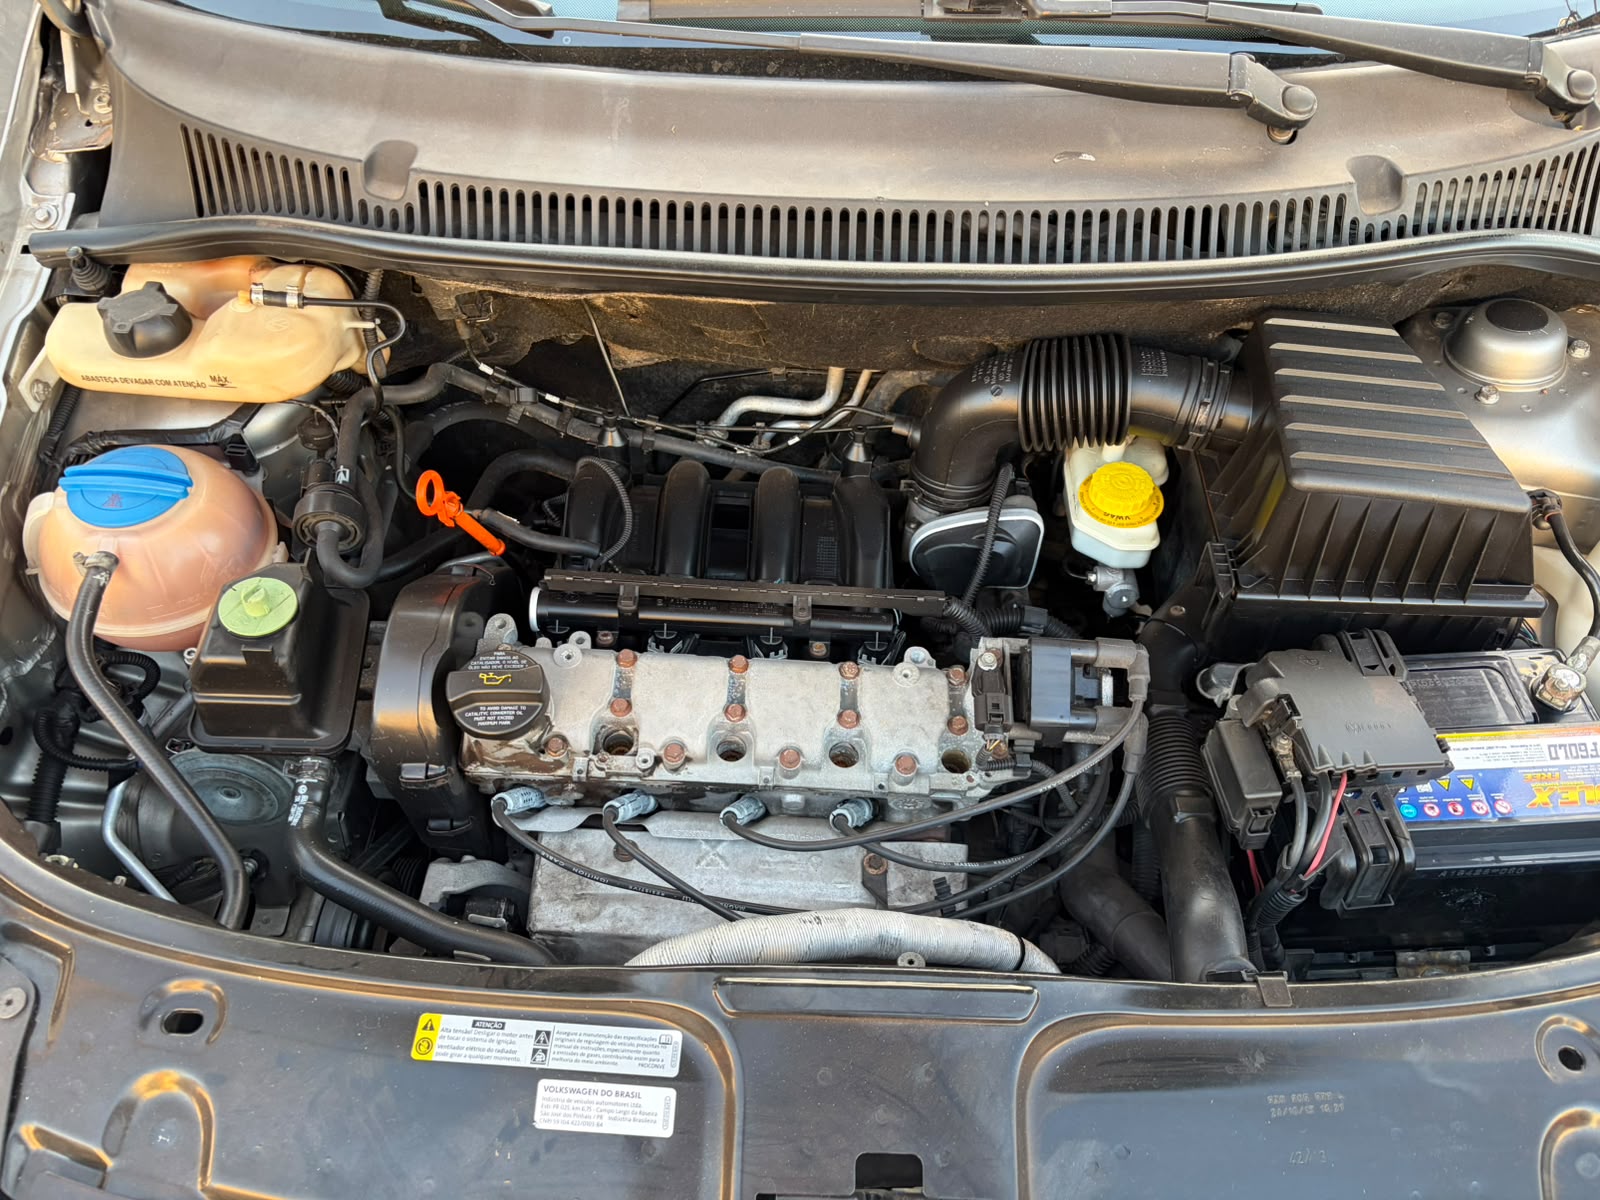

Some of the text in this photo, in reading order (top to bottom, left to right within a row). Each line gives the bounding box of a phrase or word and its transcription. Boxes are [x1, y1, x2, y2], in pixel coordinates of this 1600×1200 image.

[81, 375, 119, 384] ABASTEÇA
[173, 380, 206, 388] ATENÇÃO
[1527, 784, 1600, 808] LEX
[473, 1029, 495, 1037] Desligar
[543, 1085, 598, 1095] VOLKSWAGEN
[614, 1090, 641, 1098] BRASIL
